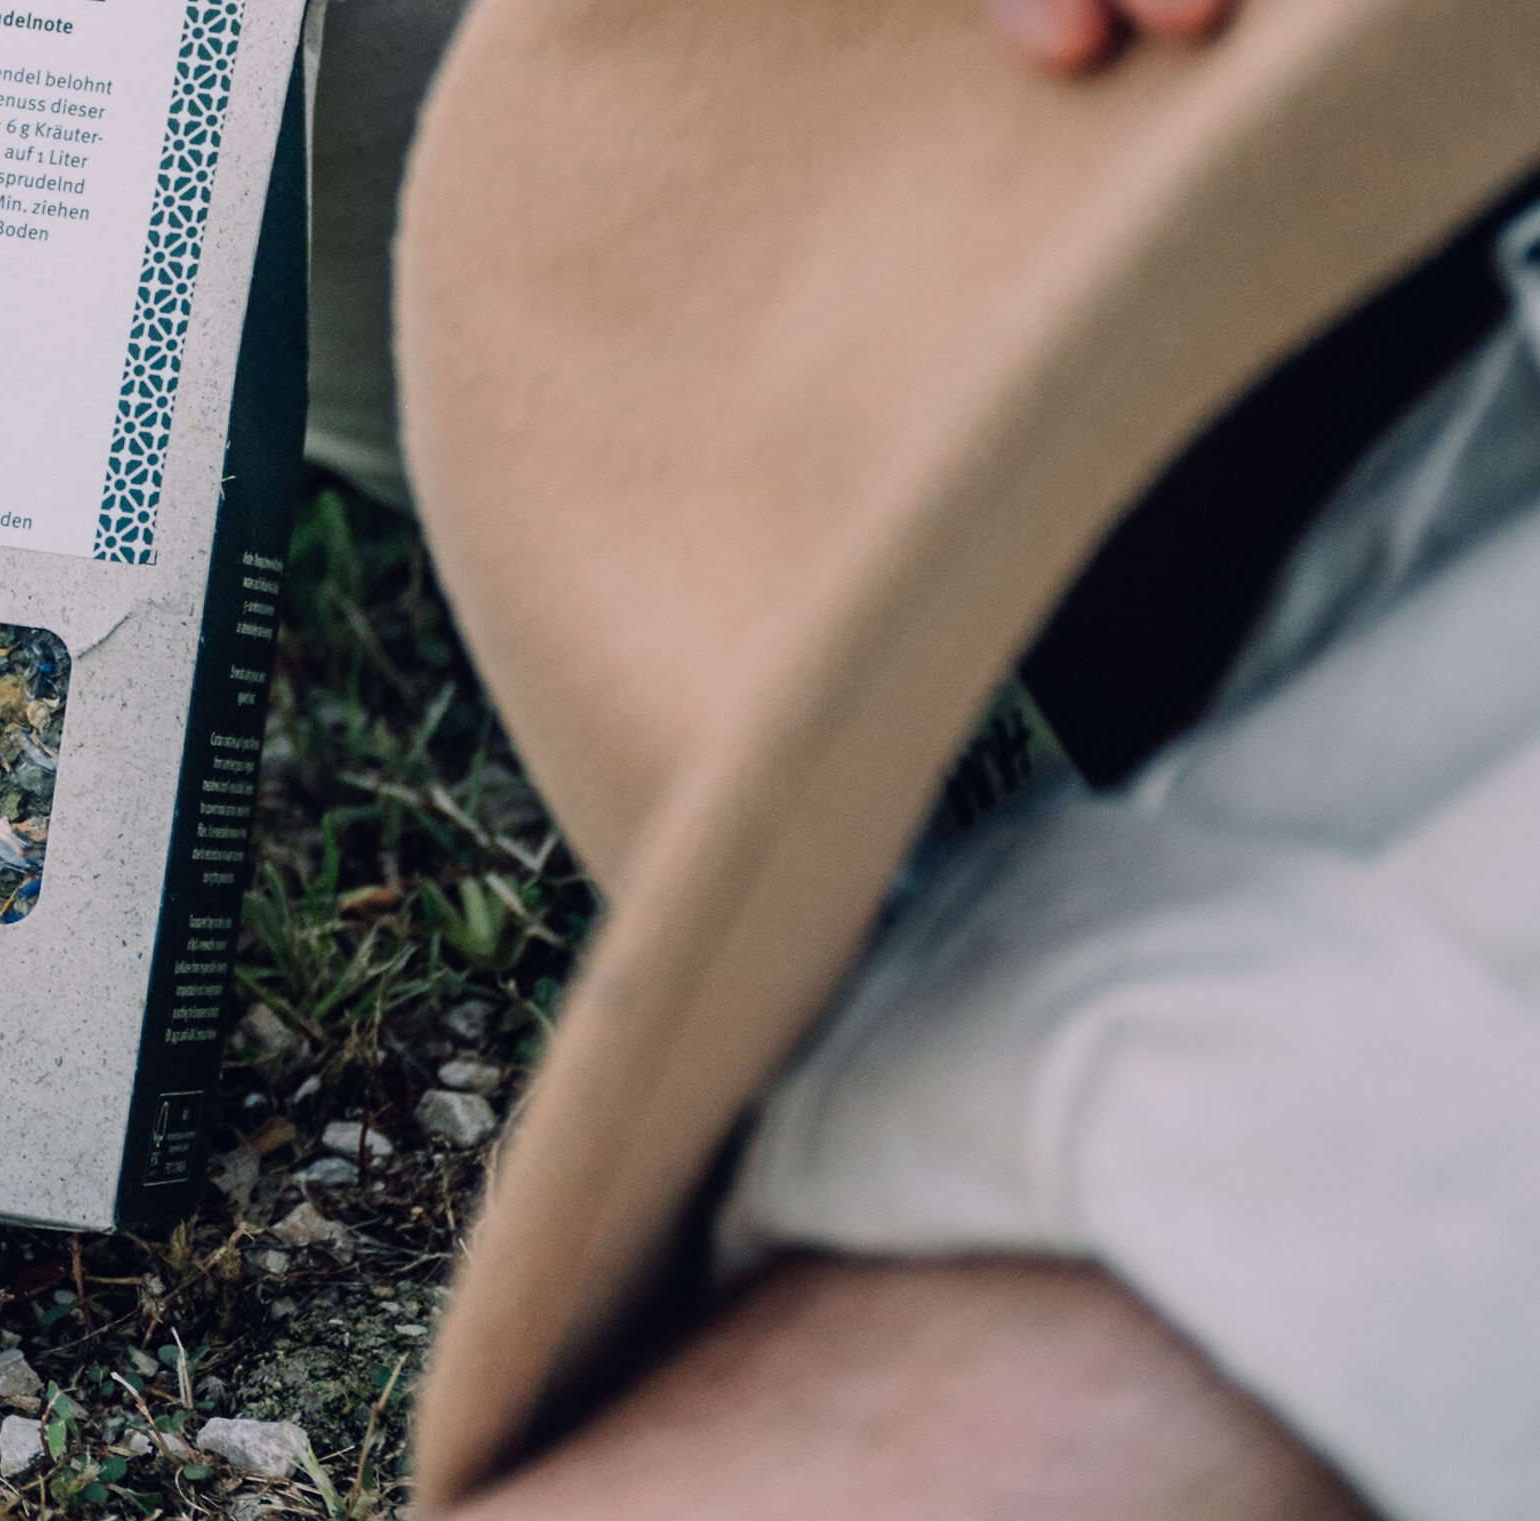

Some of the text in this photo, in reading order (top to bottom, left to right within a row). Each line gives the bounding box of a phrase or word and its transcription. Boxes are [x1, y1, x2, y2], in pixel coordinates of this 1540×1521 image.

[45, 71, 113, 95] belohnt
[50, 98, 106, 119] dieser
[35, 122, 103, 144] Kräuter-
[4, 146, 35, 161] auf
[37, 152, 43, 164] 1
[49, 149, 89, 169] Liter
[31, 200, 90, 221] ziehen
